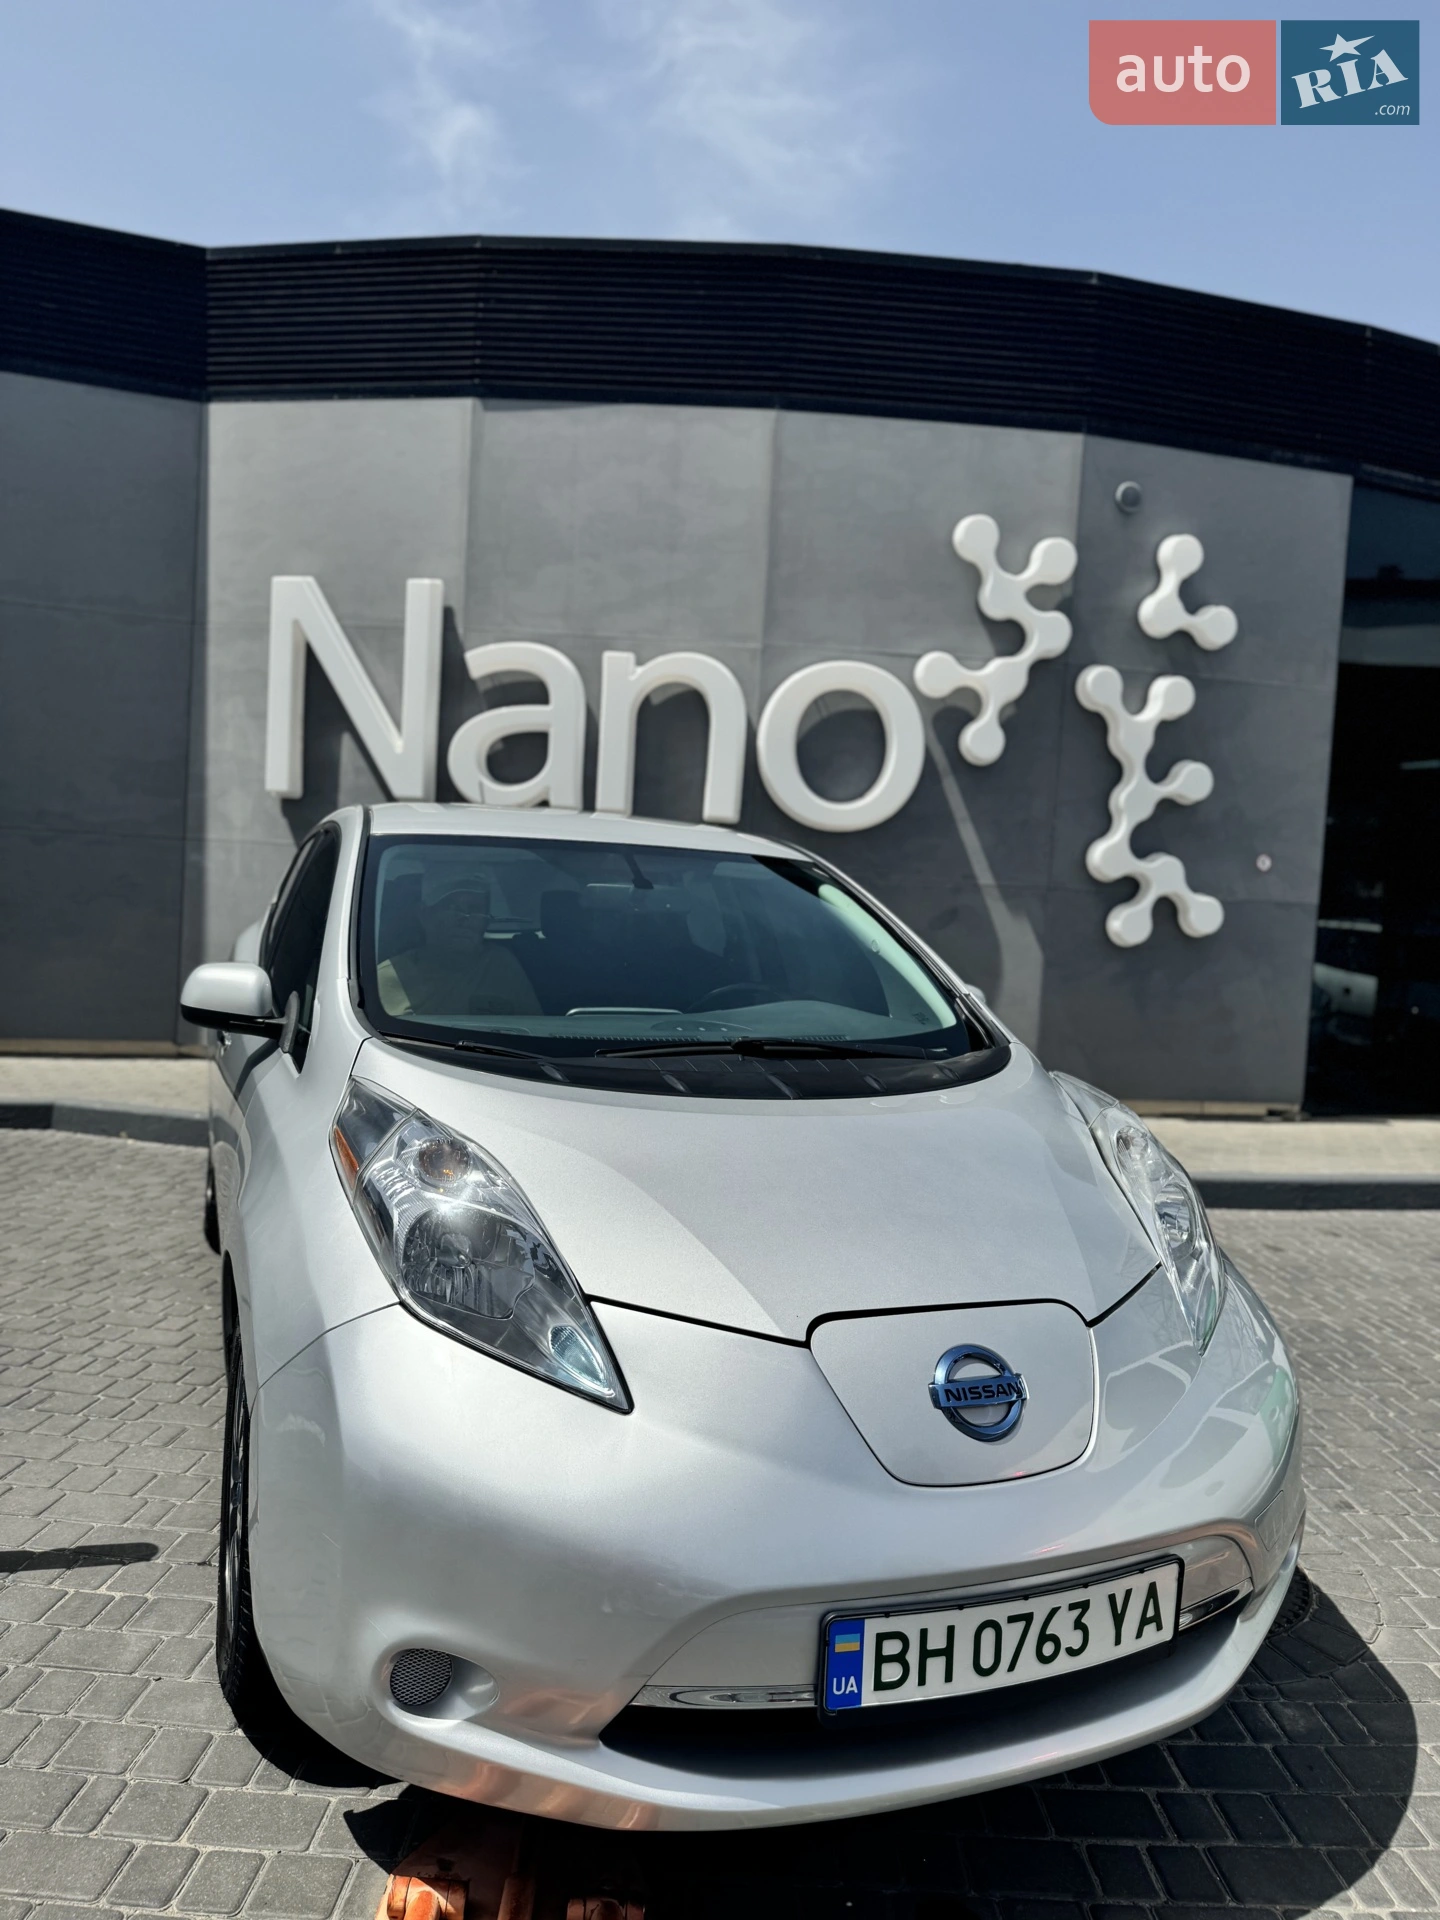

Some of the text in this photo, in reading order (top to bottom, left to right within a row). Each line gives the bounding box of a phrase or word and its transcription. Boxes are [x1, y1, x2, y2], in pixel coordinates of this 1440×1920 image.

[265, 575, 926, 833] Nano
[944, 1380, 1021, 1403] NISSAN
[873, 1581, 1163, 1691] BH 0763 YA
[832, 1675, 859, 1696] UA
